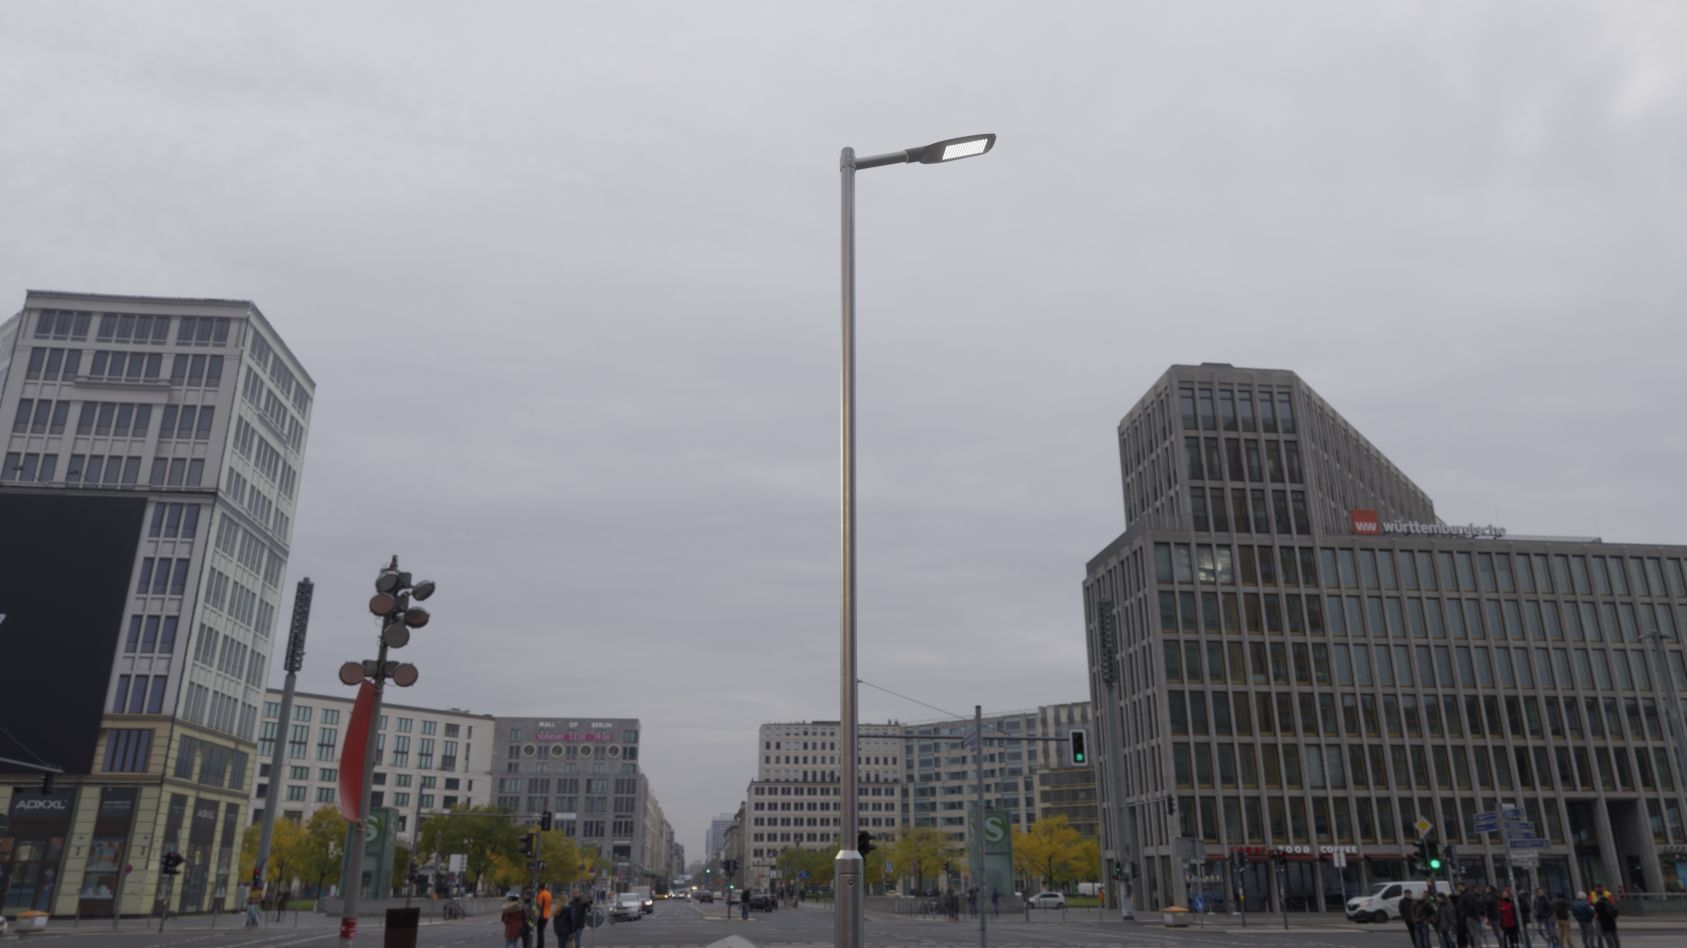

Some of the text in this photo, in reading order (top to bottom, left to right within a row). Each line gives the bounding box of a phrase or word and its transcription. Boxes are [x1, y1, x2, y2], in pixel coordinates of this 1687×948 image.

[1383, 519, 1506, 538] württembergische
[15, 799, 66, 810] ADXXL
[985, 817, 1003, 842] S
[1320, 845, 1358, 854] COFFEE
